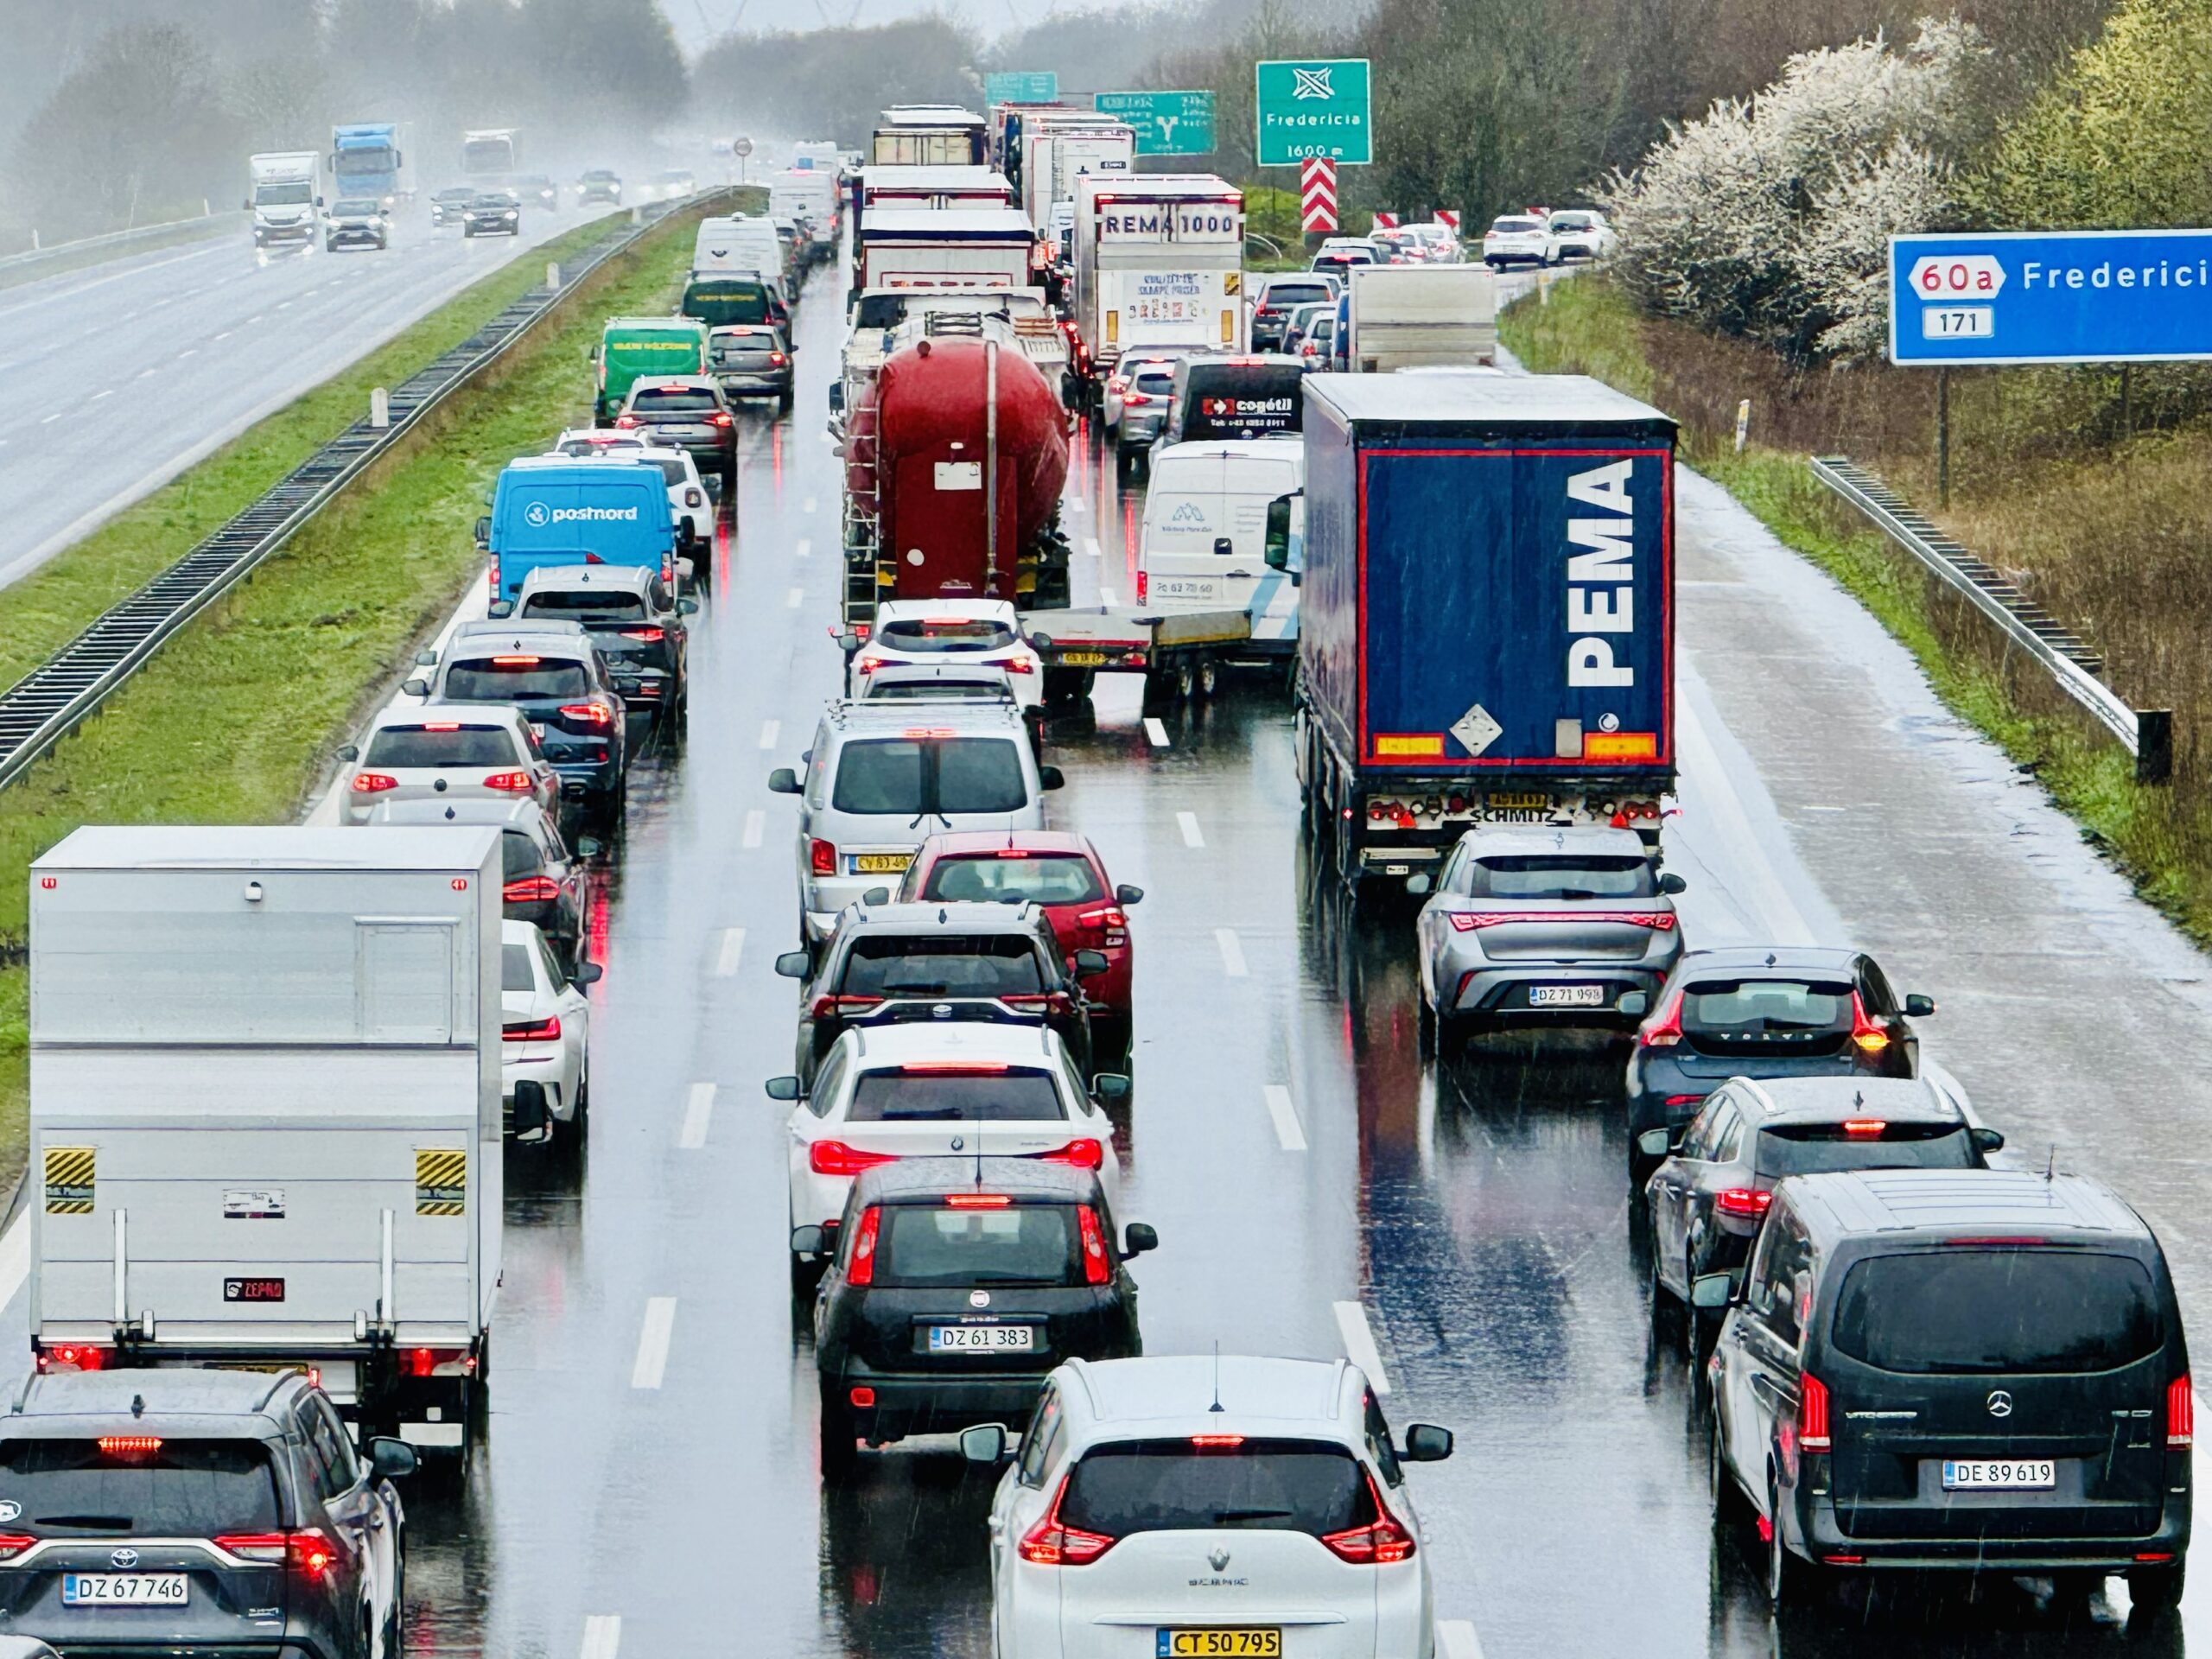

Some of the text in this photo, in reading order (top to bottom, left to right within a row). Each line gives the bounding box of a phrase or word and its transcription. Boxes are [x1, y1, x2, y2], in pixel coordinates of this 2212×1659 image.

[1266, 112, 1361, 126] Fredericia
[1287, 145, 1325, 157] 1600
[1105, 215, 1232, 233] REMA 1000
[1922, 264, 1993, 291] 60a
[1940, 314, 1977, 333] 171
[552, 505, 638, 523] postnord
[1566, 457, 1634, 687] PEMA
[1470, 809, 1557, 823] SCHMITZ
[944, 1330, 1028, 1345] DZ 61 383
[1958, 1464, 2050, 1483] DE 89 619
[79, 1577, 183, 1599] DZ 67 746
[1174, 1633, 1277, 1653] CT 50 795
